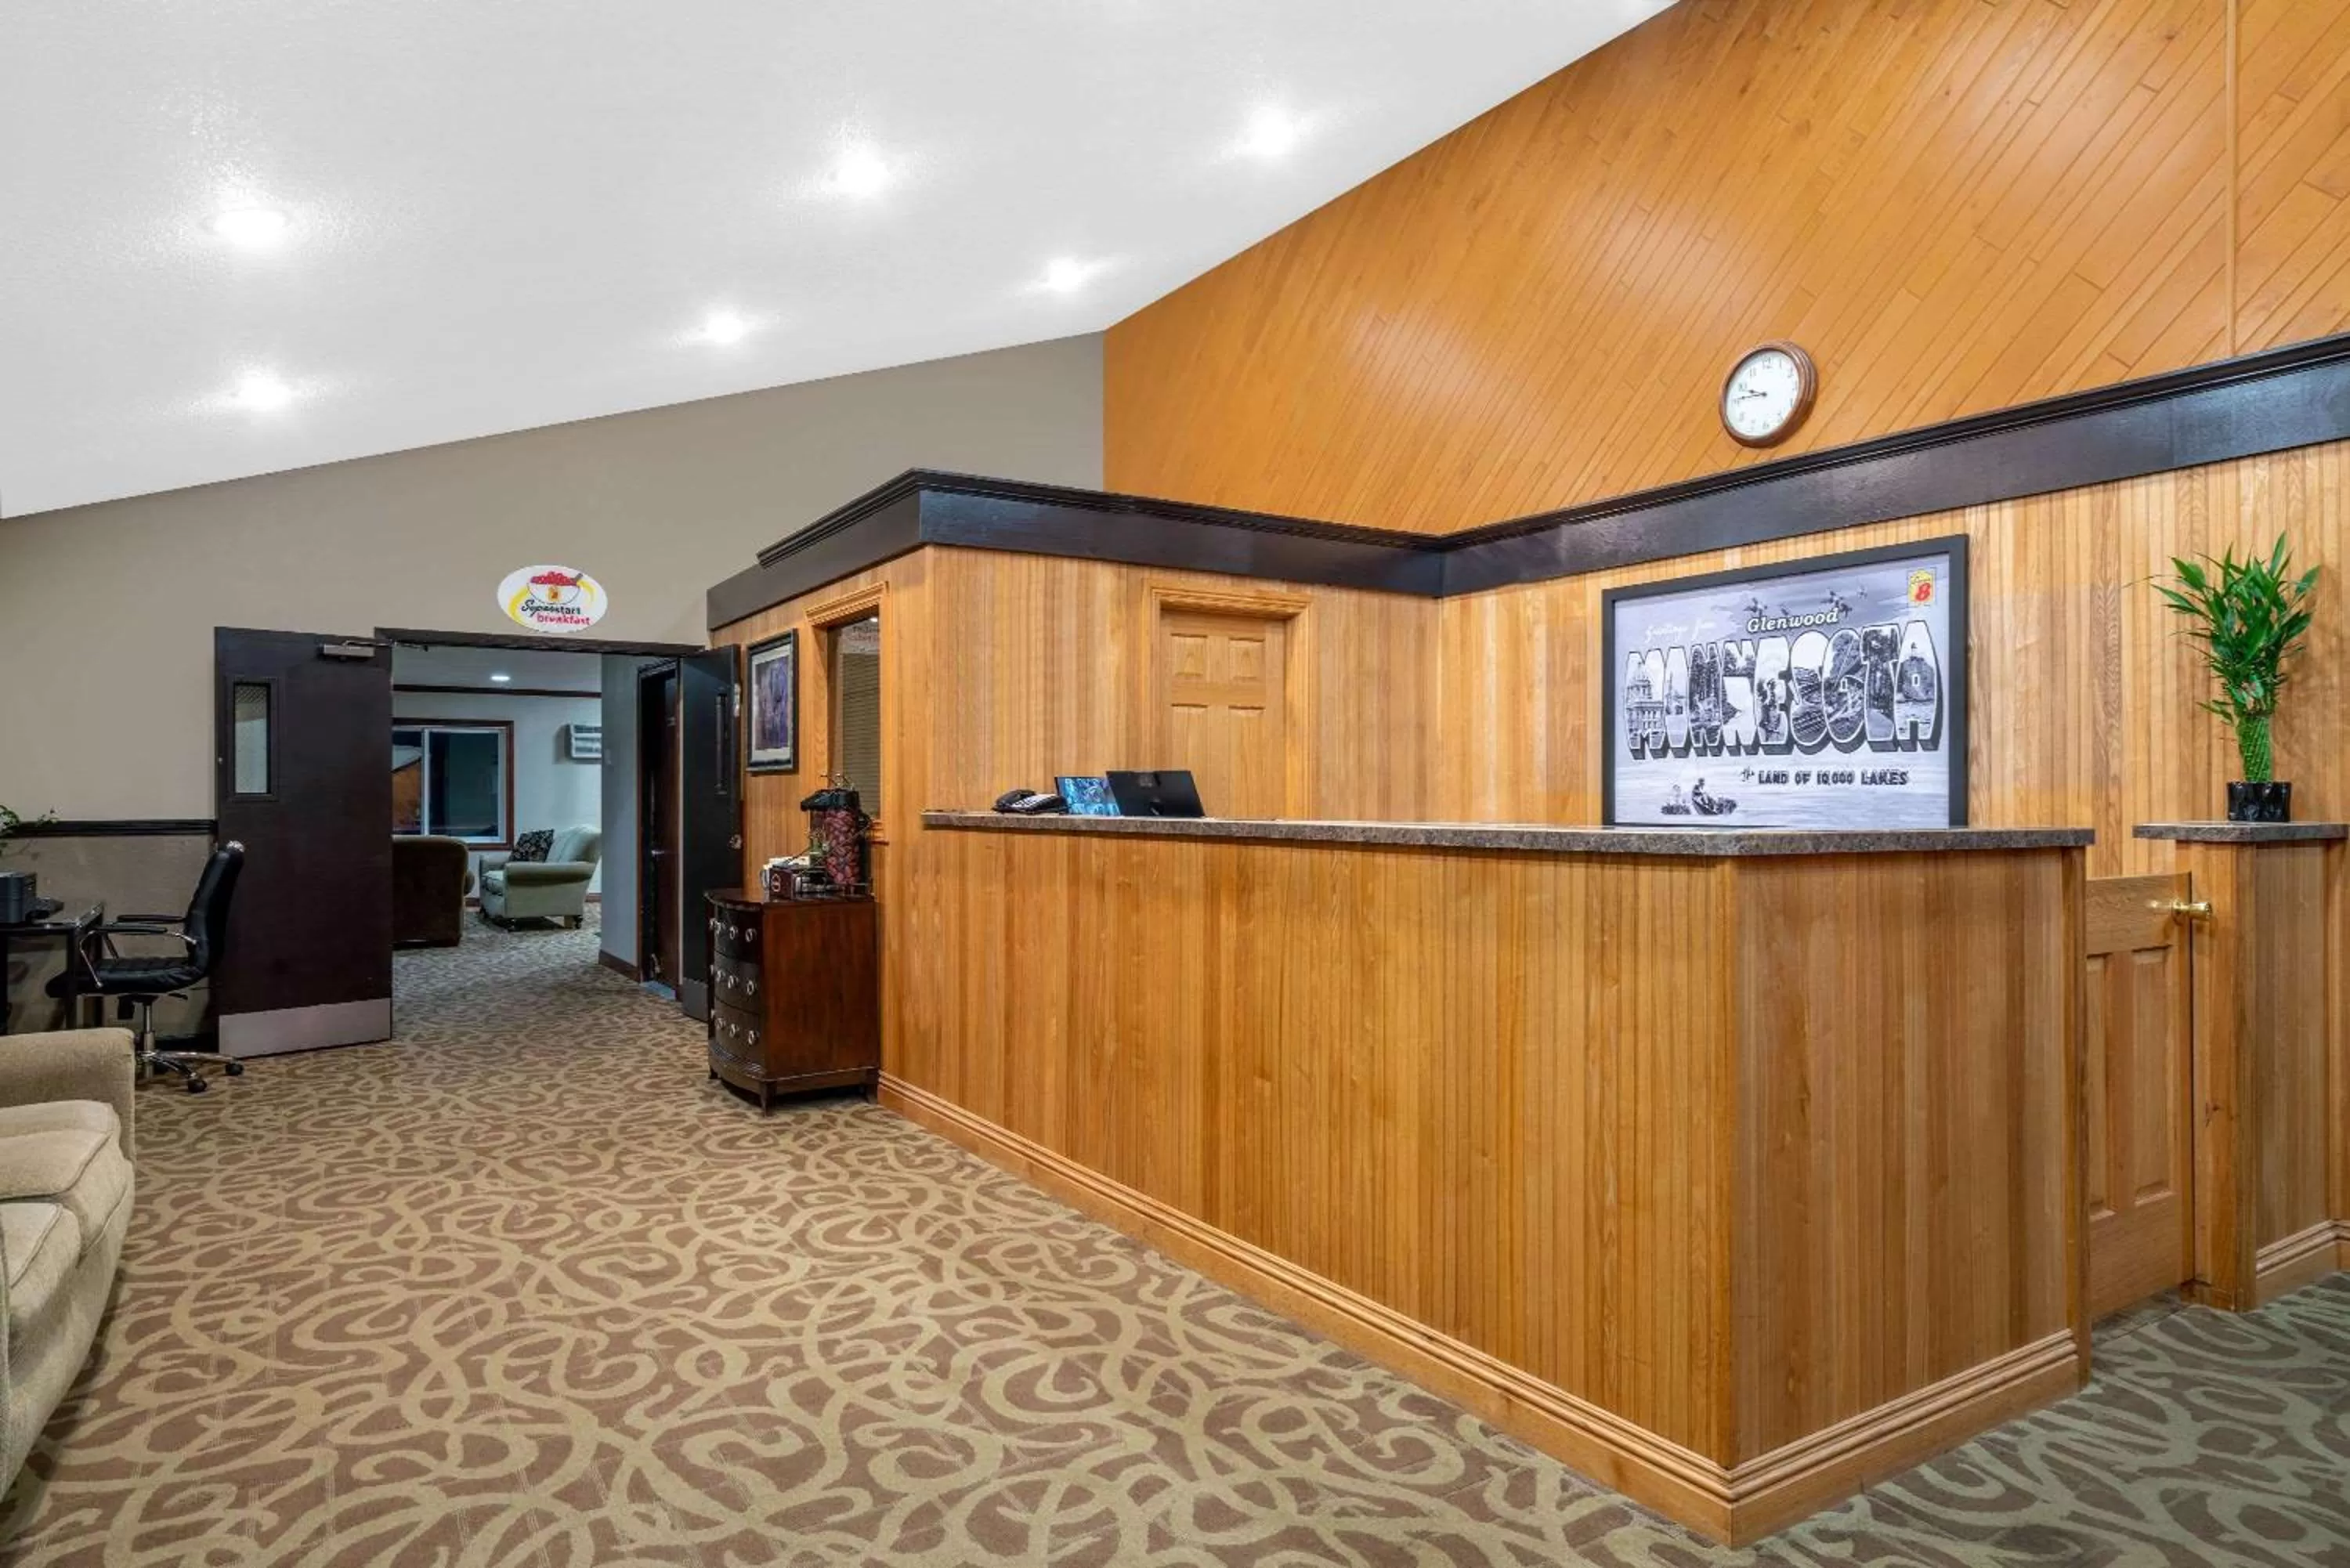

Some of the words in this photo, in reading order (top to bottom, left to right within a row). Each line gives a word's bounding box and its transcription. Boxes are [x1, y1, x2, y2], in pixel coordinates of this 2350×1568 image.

[1915, 582, 1931, 602] 8
[537, 612, 590, 625] breakfast
[1747, 608, 1839, 634] Glenwood
[1625, 620, 1943, 760] MINNESOTA
[1758, 770, 1789, 784] LAND
[1795, 771, 1812, 784] OF
[1860, 769, 1909, 785] LAKES
